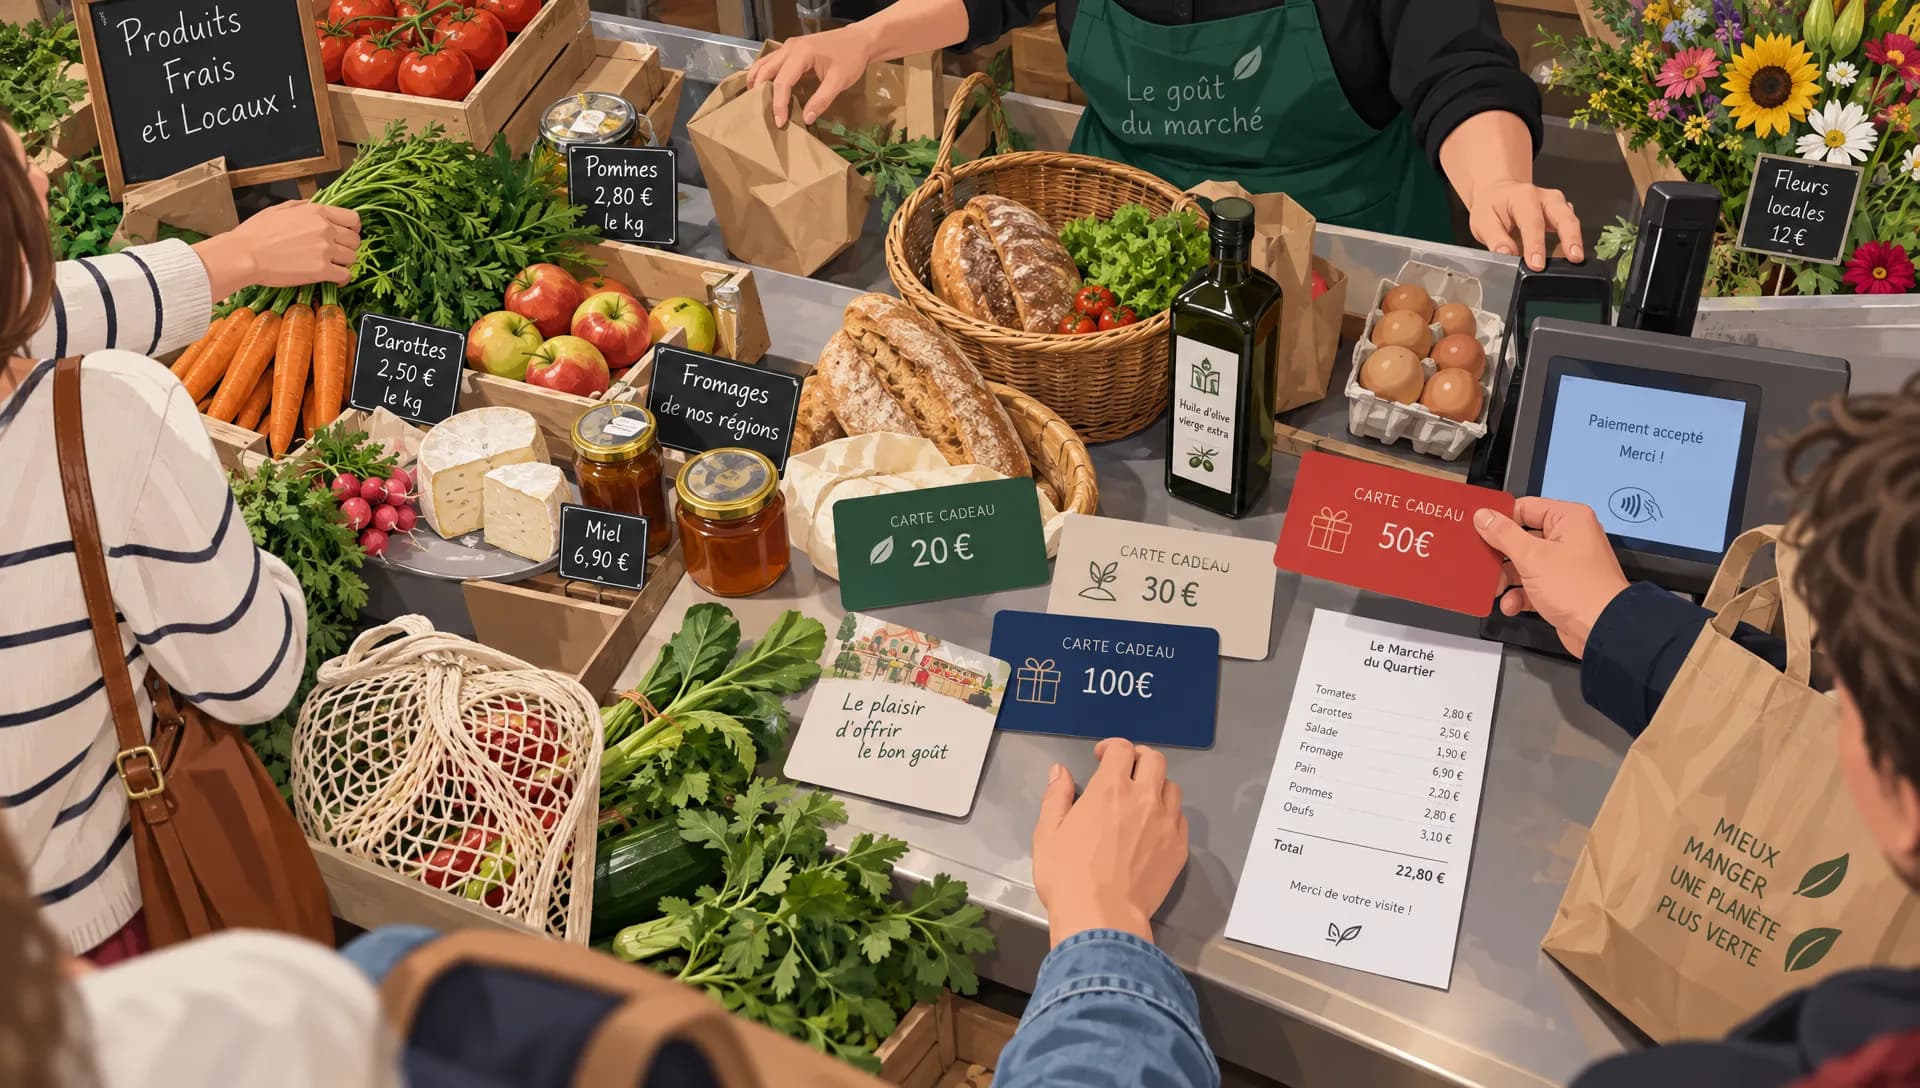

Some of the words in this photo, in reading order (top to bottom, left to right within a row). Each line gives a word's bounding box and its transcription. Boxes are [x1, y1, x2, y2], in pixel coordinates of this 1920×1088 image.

[116, 5, 241, 56] Produits
[163, 57, 236, 94] Frais
[142, 110, 170, 143] et
[181, 94, 279, 134] Locaux
[288, 74, 297, 109] !
[1127, 74, 1155, 102] Le
[1167, 74, 1225, 112] goût
[1121, 109, 1152, 136] du
[1164, 106, 1264, 136] marché
[585, 155, 658, 178] Pommes
[1774, 169, 1830, 196] Fleurs
[594, 186, 634, 208] 2,80
[640, 187, 654, 206] €
[1767, 195, 1825, 222] locales
[604, 212, 618, 230] le
[624, 212, 644, 238] kg
[376, 358, 418, 382] 2,50
[422, 368, 436, 387] €
[682, 364, 769, 408] Fromages
[383, 386, 397, 404] le
[403, 390, 422, 416] kg
[660, 394, 680, 416] de
[685, 406, 713, 424] nos
[718, 413, 780, 441] régions
[1179, 398, 1202, 415] Huile
[1203, 407, 1231, 424] d'olive
[1179, 416, 1205, 432] vierge
[1206, 426, 1229, 439] extra
[1588, 413, 1650, 436] Paiement
[1652, 426, 1704, 446] accepté
[1619, 444, 1656, 464] Merci
[1659, 451, 1664, 464] !
[890, 510, 936, 529] CARTE
[938, 503, 996, 522] CADEAU
[1354, 487, 1401, 509] CARTE
[1405, 498, 1465, 522] CADEAU
[585, 520, 621, 544] Miel
[1378, 522, 1434, 558] 50€
[574, 546, 612, 569] 6,90
[617, 552, 630, 572] €
[1120, 544, 1166, 564] CARTE
[1170, 552, 1232, 574] CADEAU
[1062, 636, 1111, 654] CARTE
[1115, 641, 1176, 660] CADEAU
[1370, 640, 1384, 652] Le
[1388, 643, 1434, 662] Marché
[1082, 666, 1154, 699] 100€
[1363, 656, 1380, 668] du
[1382, 659, 1436, 678] Quartier
[842, 692, 864, 711] Le
[868, 694, 926, 719] plaisir
[1315, 684, 1356, 701] Tomates
[1442, 708, 1464, 720] 2,80
[1466, 711, 1473, 722] €
[836, 720, 902, 742] d'offrir
[1310, 703, 1353, 720] Carottes
[1439, 727, 1461, 740] 2,50
[1463, 730, 1470, 741] €
[857, 742, 872, 759] le
[877, 742, 905, 760] bon
[908, 744, 949, 768] goût
[1304, 722, 1338, 738] Salade
[1436, 746, 1458, 760] 1,90
[1460, 750, 1467, 761] €
[1299, 741, 1344, 760] Fromage
[1432, 766, 1454, 780] 6,90
[1456, 770, 1464, 781] €
[1294, 762, 1316, 776] Pain
[1428, 787, 1451, 800] 2,20
[1452, 791, 1460, 802] €
[1288, 781, 1334, 800] Pommes
[1423, 808, 1447, 822] 2,80
[1449, 812, 1457, 823] €
[1282, 801, 1315, 818] Oeufs
[1419, 829, 1443, 844] 3,10
[1445, 833, 1453, 845] €
[1713, 816, 1781, 869] MIEUX
[1273, 838, 1304, 856] Total
[1395, 864, 1433, 882] 22,80
[1436, 872, 1446, 885] €
[1682, 835, 1768, 900] MANGER
[1289, 880, 1322, 898] Merci
[1324, 888, 1339, 900] de
[1342, 893, 1372, 908] votre
[1374, 900, 1405, 915] visite
[1407, 904, 1413, 916] !
[1670, 864, 1706, 899] UNE
[1706, 886, 1782, 942] PLANÈTE
[1656, 894, 1702, 934] PLUS
[1706, 920, 1762, 968] VERTE
